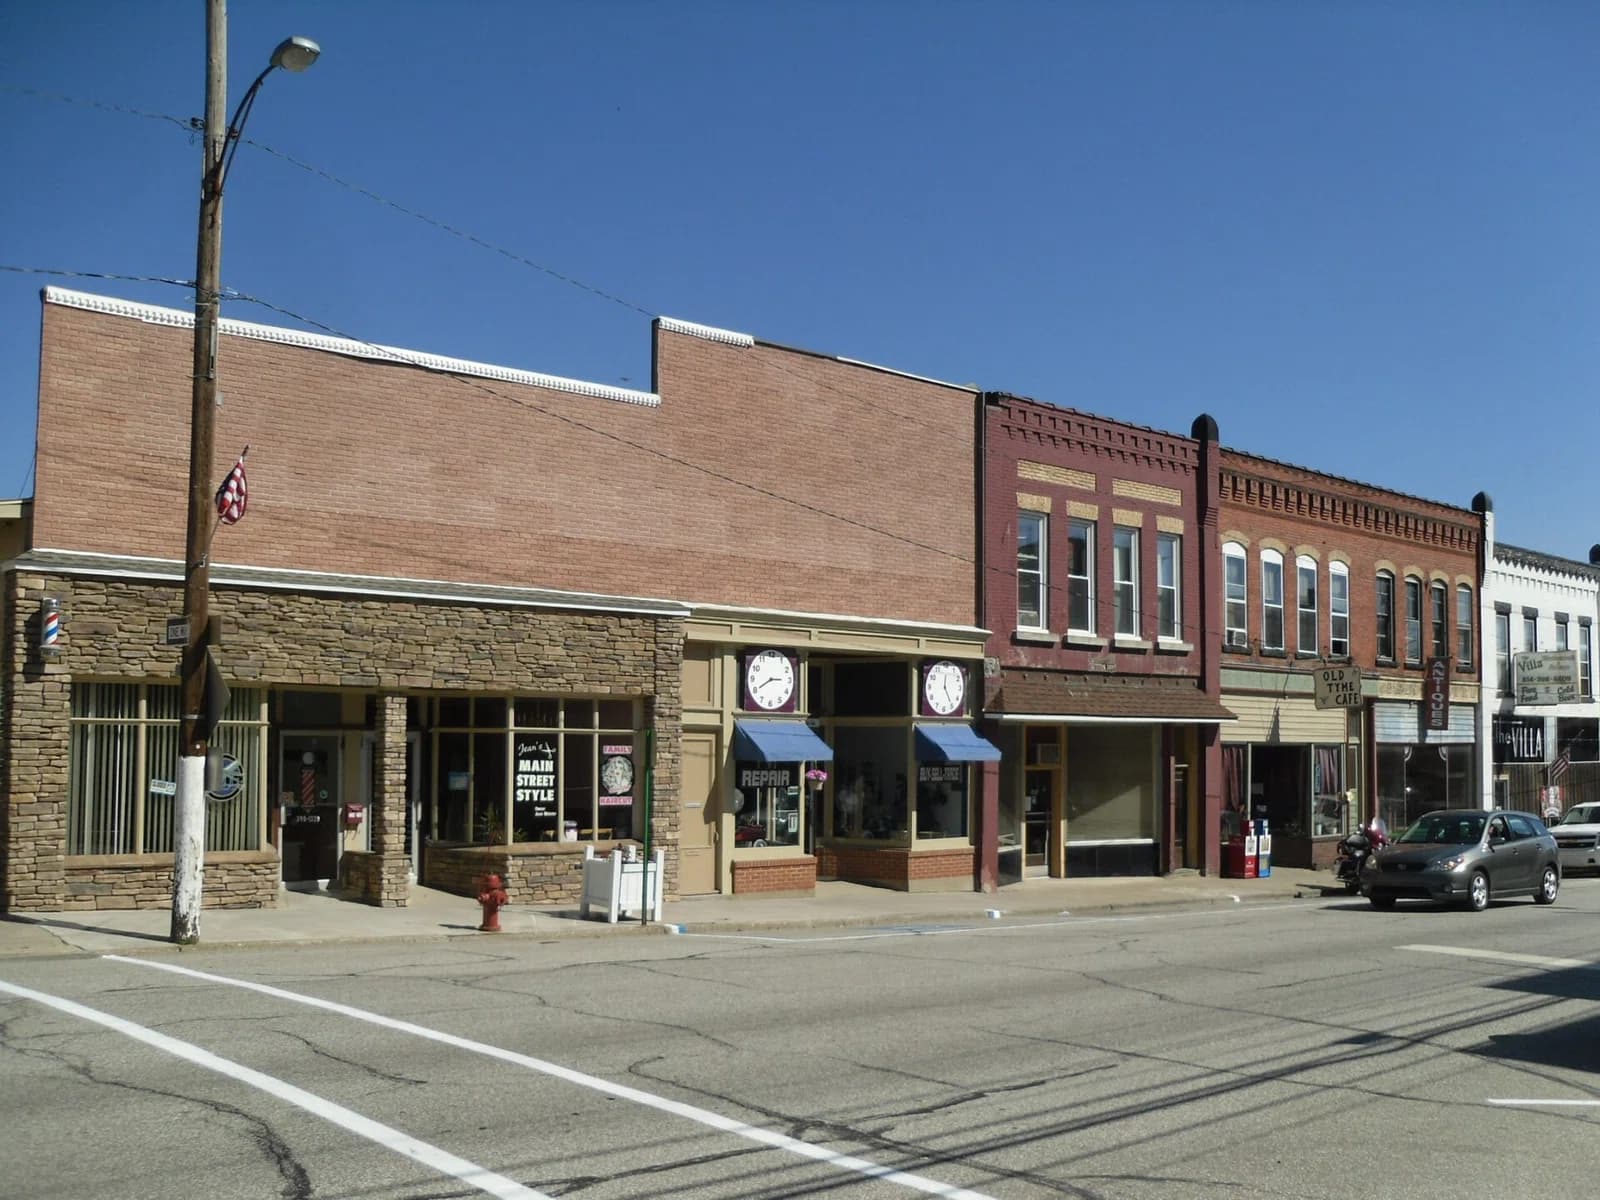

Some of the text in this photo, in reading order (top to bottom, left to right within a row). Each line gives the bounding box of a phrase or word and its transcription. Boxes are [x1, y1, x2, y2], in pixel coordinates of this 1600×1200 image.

[780, 656, 784, 664] 1
[1518, 659, 1543, 672] Villa
[752, 664, 760, 672] 10
[1323, 670, 1344, 681] OLD
[753, 686, 758, 694] 8
[1327, 681, 1354, 693] TYME
[777, 696, 783, 704] 5
[1336, 692, 1359, 705] CAFE
[1431, 661, 1445, 727] ANTIQUES
[1511, 727, 1543, 758] VILLA
[518, 741, 543, 757] Jean's
[603, 745, 632, 754] FAMILY
[519, 760, 554, 772] MAIN
[516, 774, 555, 787] STREET
[742, 770, 790, 787] REPAIR
[516, 789, 555, 802] STYLE
